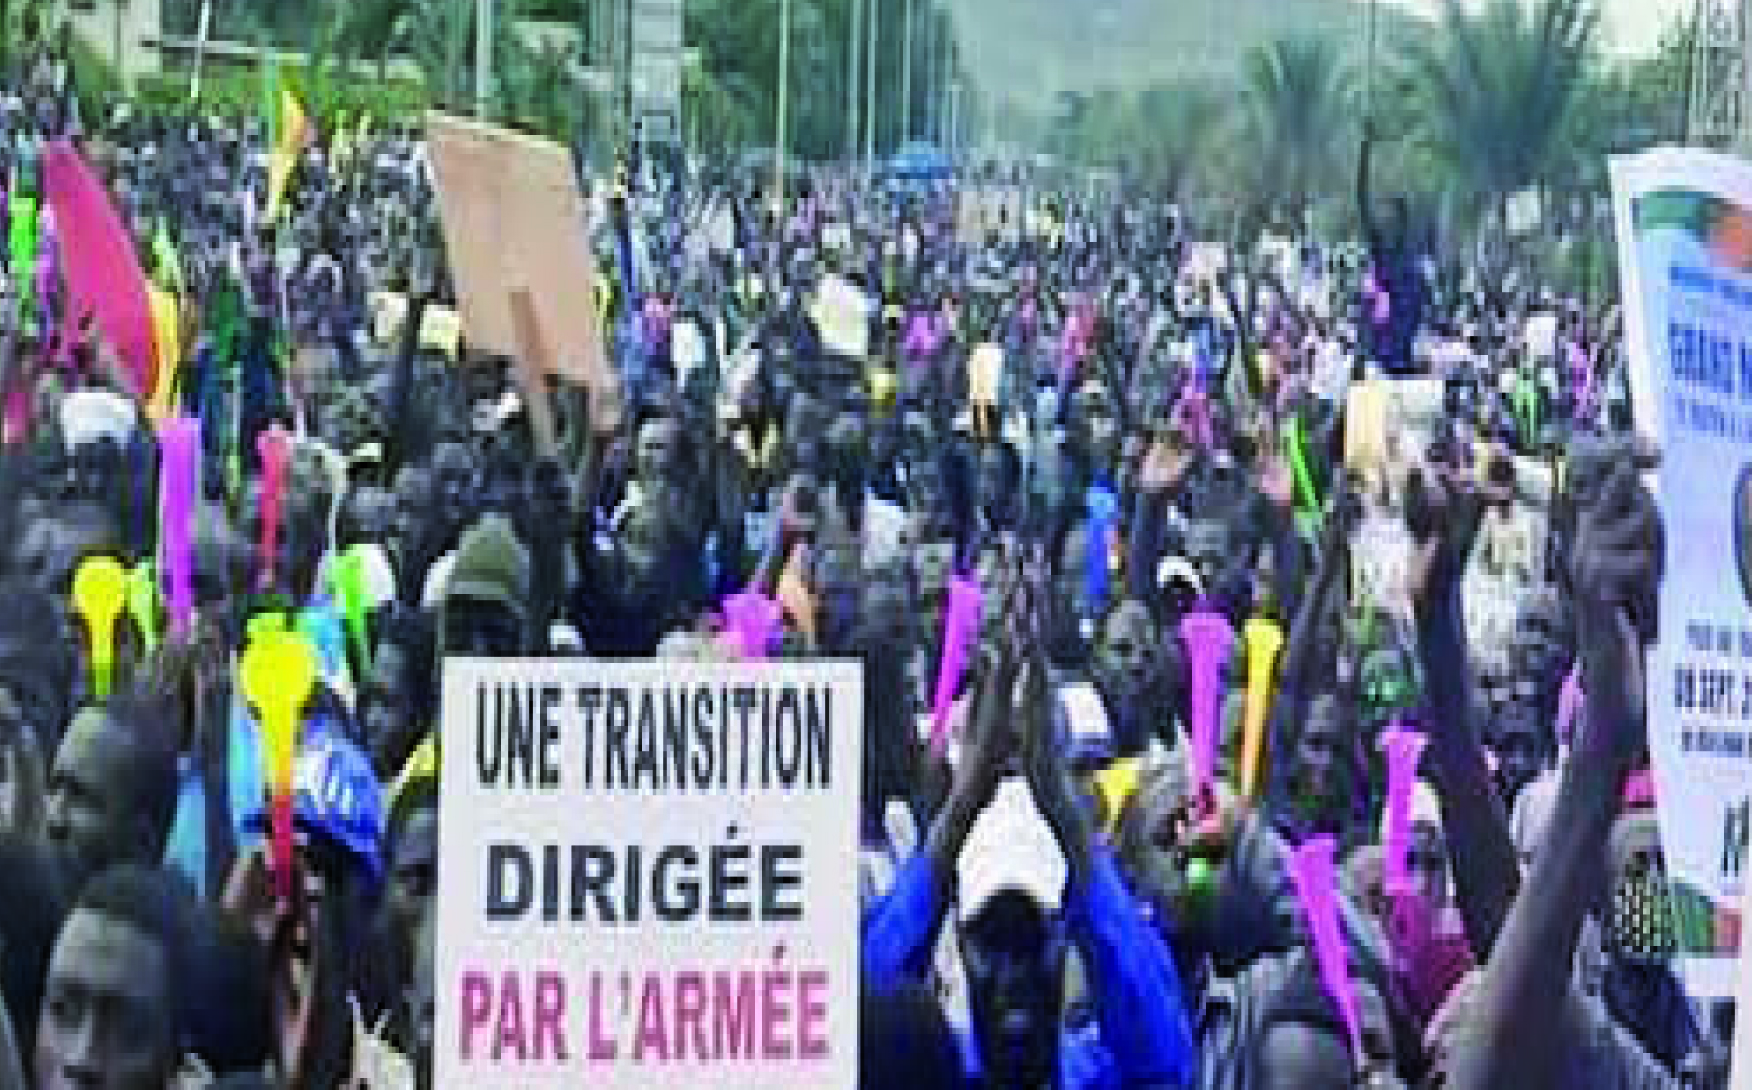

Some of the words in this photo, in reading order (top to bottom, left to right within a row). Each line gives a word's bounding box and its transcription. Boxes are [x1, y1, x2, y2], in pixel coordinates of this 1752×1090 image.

[476, 682, 561, 787] UNE
[577, 687, 829, 788] TRANSITION
[486, 821, 804, 921] DIRIGÉE
[459, 970, 568, 1059] PAR
[587, 941, 829, 1060] L'ARMÉE
